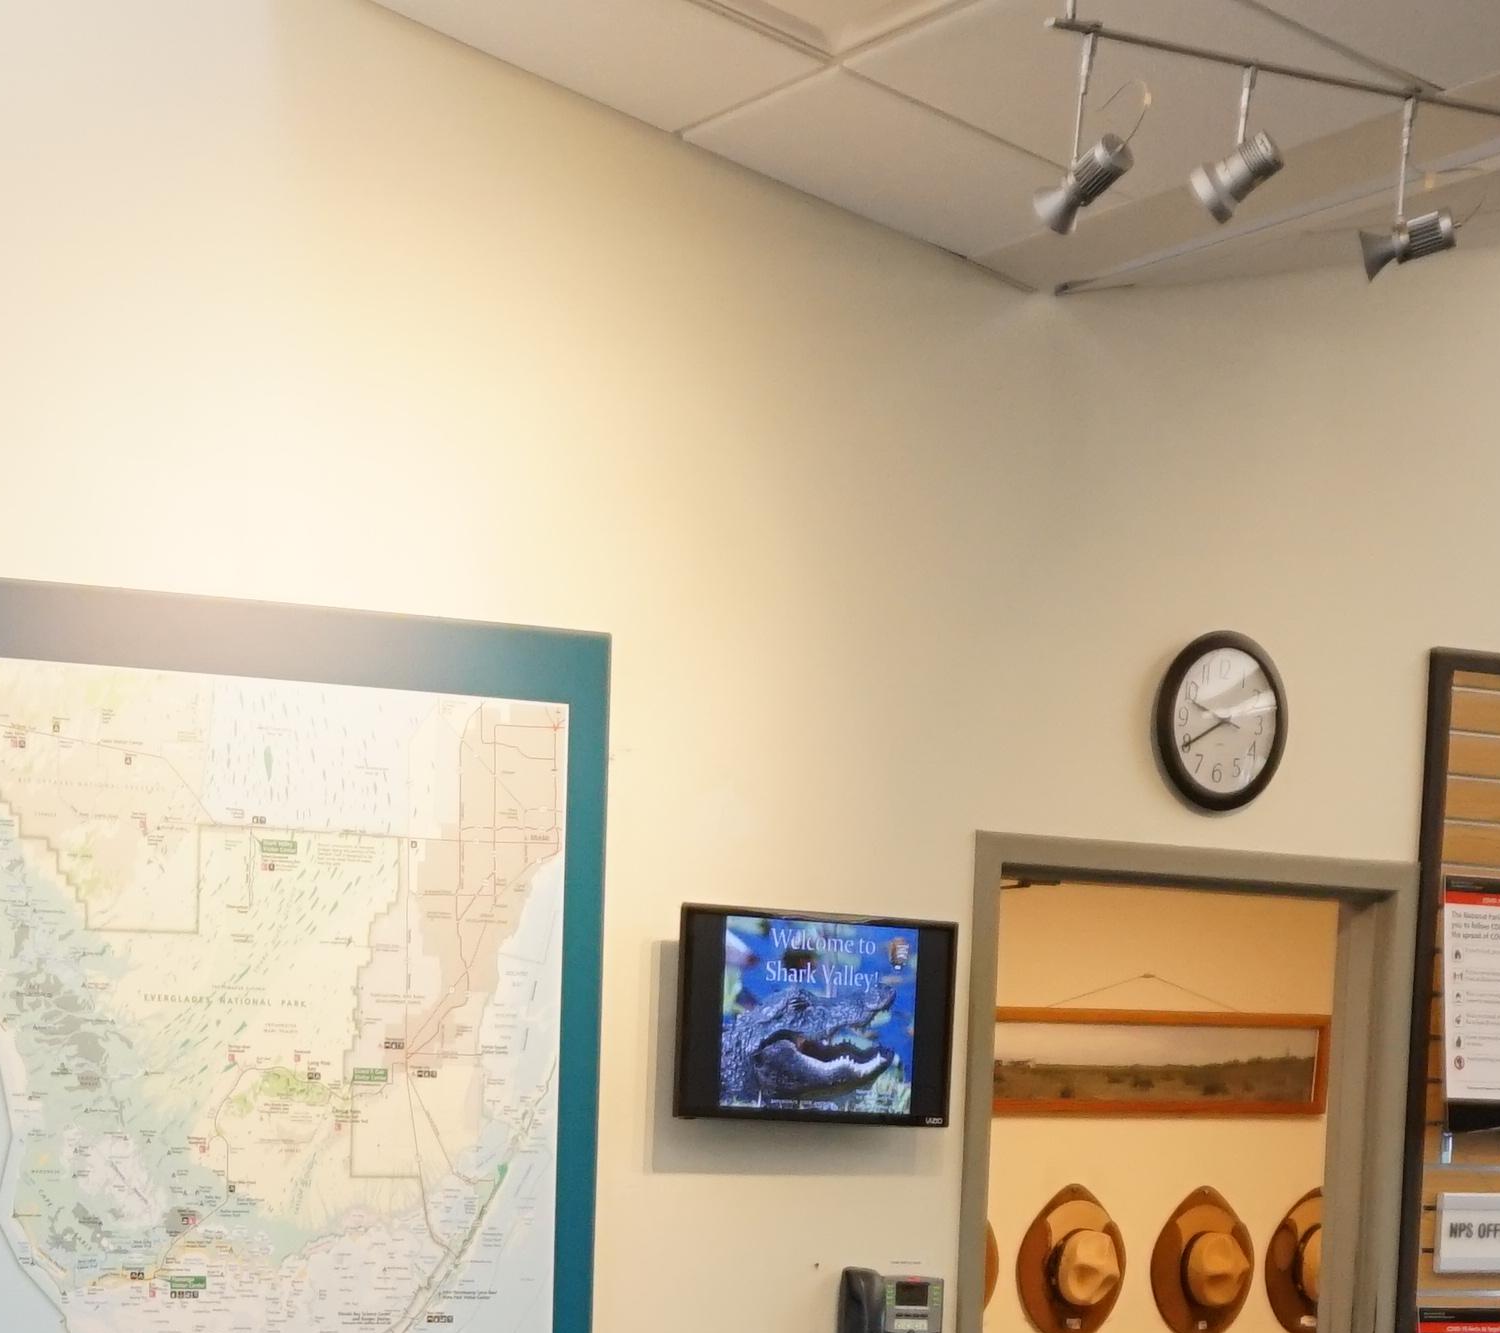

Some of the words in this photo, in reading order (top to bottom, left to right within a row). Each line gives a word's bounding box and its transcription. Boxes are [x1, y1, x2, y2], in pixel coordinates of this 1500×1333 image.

[771, 928, 854, 953] Welcome
[859, 938, 876, 955] to
[766, 961, 816, 983] Shark
[822, 964, 880, 992] Valley!
[1449, 1222, 1473, 1238] NPS
